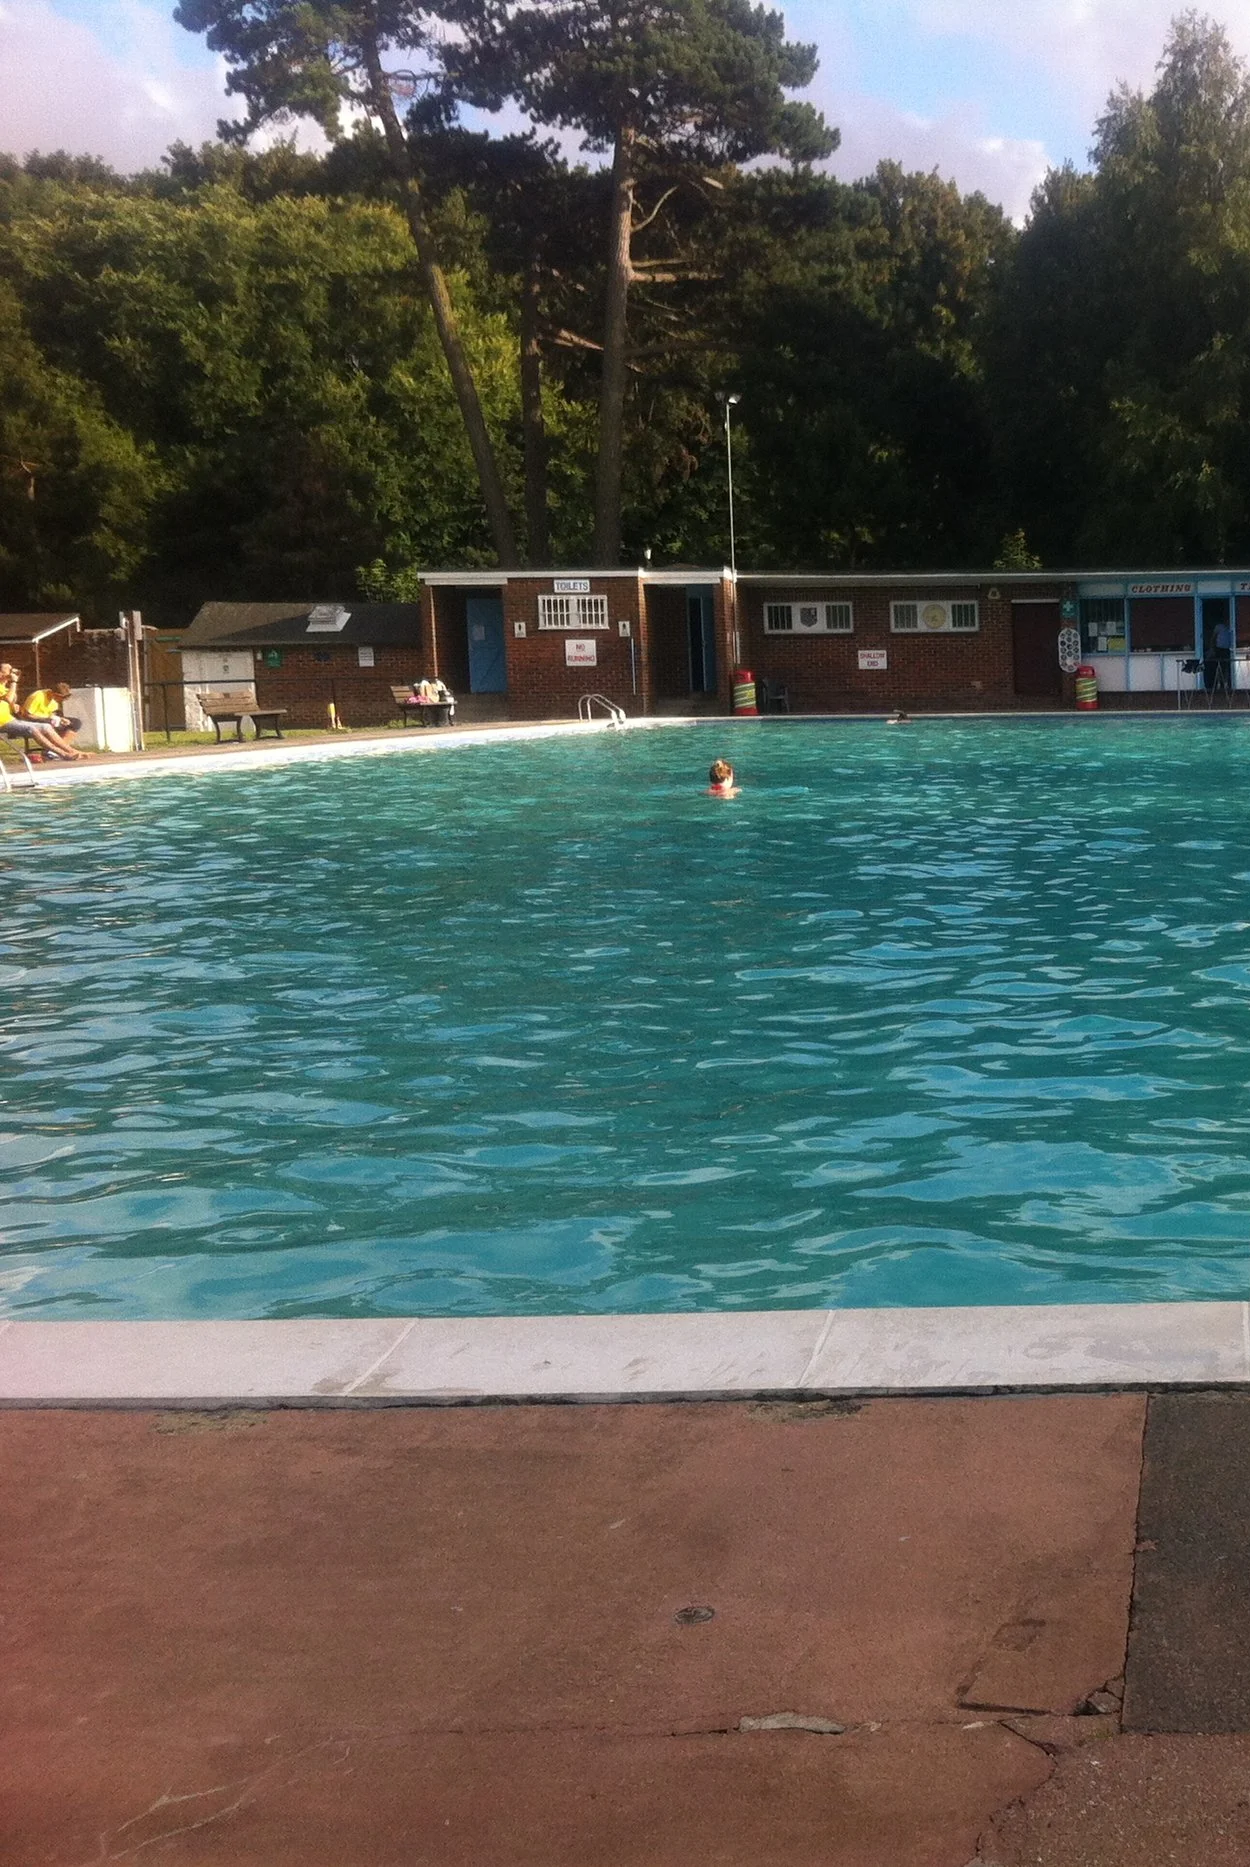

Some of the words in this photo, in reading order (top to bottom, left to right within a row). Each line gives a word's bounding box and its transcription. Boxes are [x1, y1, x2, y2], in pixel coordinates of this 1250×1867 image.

[555, 581, 589, 591] TOILETS
[1131, 583, 1191, 593] CLOTHING
[575, 643, 586, 651] NO
